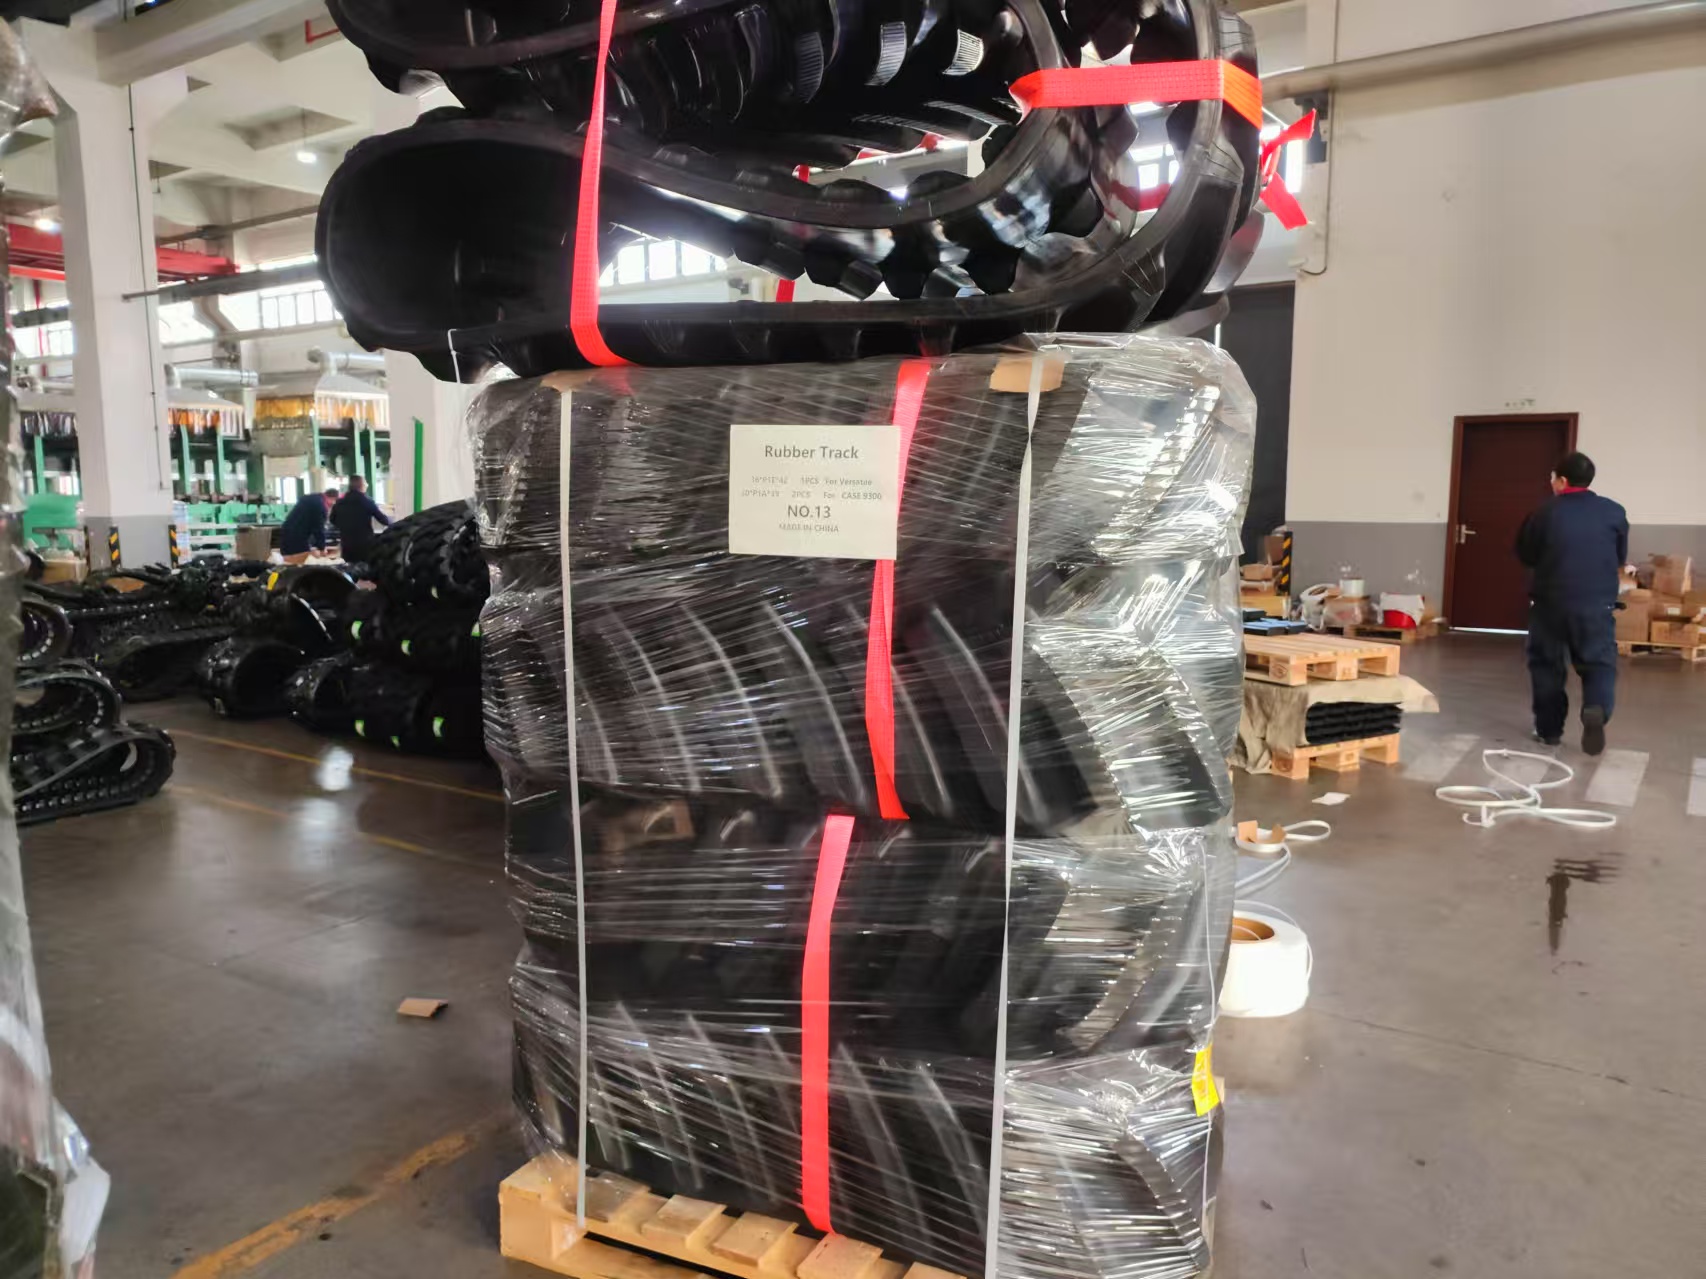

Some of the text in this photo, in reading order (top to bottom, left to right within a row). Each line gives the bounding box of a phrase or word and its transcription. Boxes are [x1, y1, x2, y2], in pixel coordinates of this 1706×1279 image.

[764, 445, 859, 459] Rubber Track
[823, 491, 835, 499] For
[841, 492, 861, 500] CASE
[862, 492, 882, 501] 9300
[787, 504, 831, 519] NO.13
[803, 524, 812, 532] IN
[814, 524, 839, 533] CHINA
